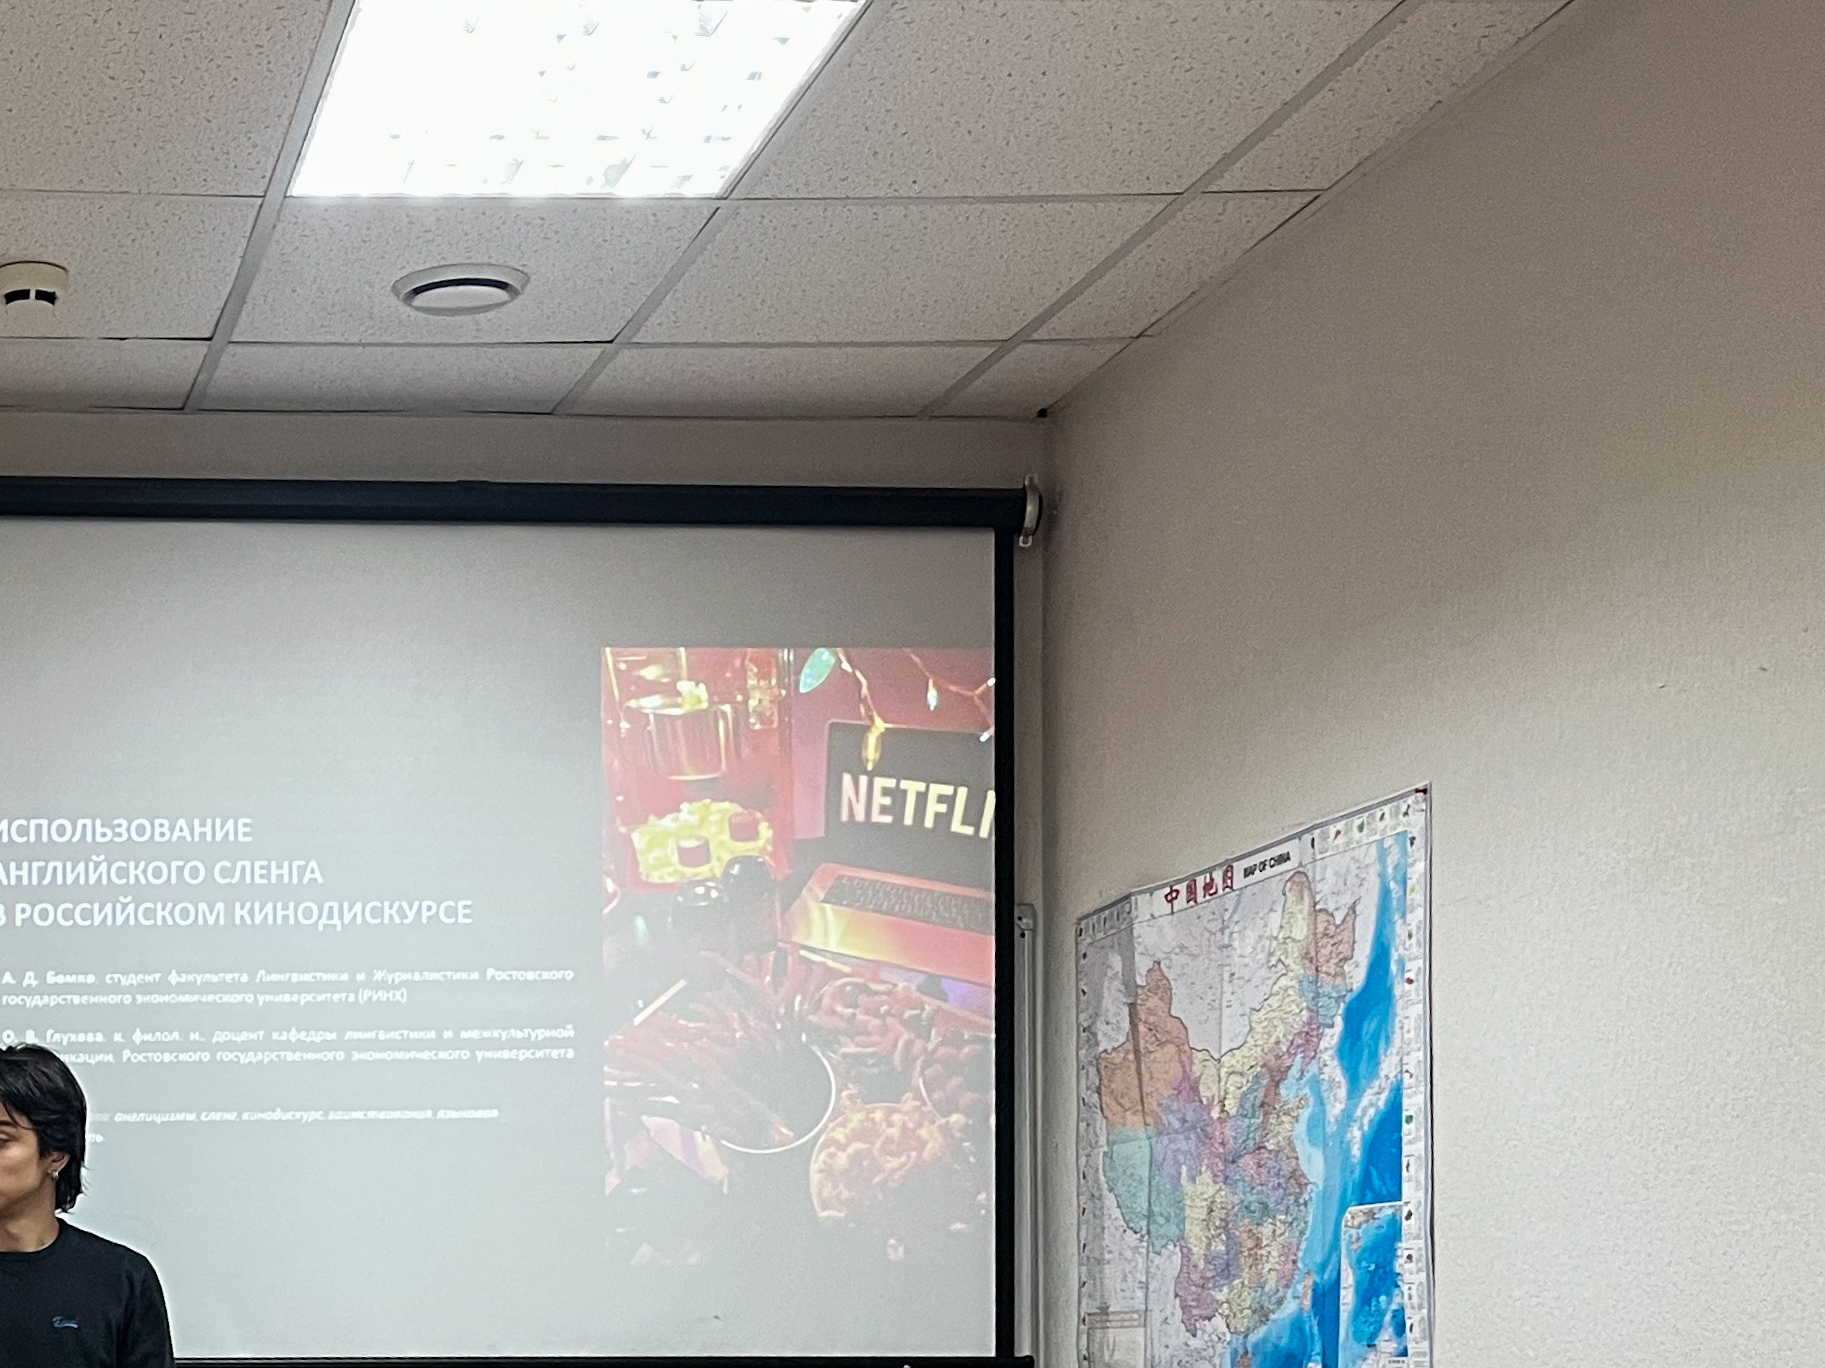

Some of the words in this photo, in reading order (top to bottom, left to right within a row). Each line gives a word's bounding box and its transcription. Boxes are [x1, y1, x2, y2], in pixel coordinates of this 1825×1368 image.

[214, 860, 324, 884] СЛЕНГА
[1243, 863, 1257, 879] MAP
[1258, 859, 1268, 872] OF
[15, 895, 225, 927] РОССИЙСКОМ
[235, 900, 472, 931] КИНОДИСКУРСЕ
[1, 970, 17, 985] А.
[104, 972, 163, 987] студент
[167, 968, 249, 987] факультета
[255, 969, 350, 984] Лингвистики
[355, 972, 366, 982] и
[372, 968, 480, 985] Журналистики
[485, 967, 575, 982] Ростовского
[1, 993, 133, 1009] государственного
[256, 992, 356, 1007] университета
[357, 986, 408, 1005] (РИНХ)
[211, 1030, 266, 1045] доцент
[271, 1026, 338, 1044] кафедры
[343, 1029, 437, 1041] лингвистики
[442, 1029, 454, 1040] и
[122, 1048, 212, 1064] Ростовского
[216, 1050, 346, 1065] государственного
[474, 1048, 575, 1063] университета
